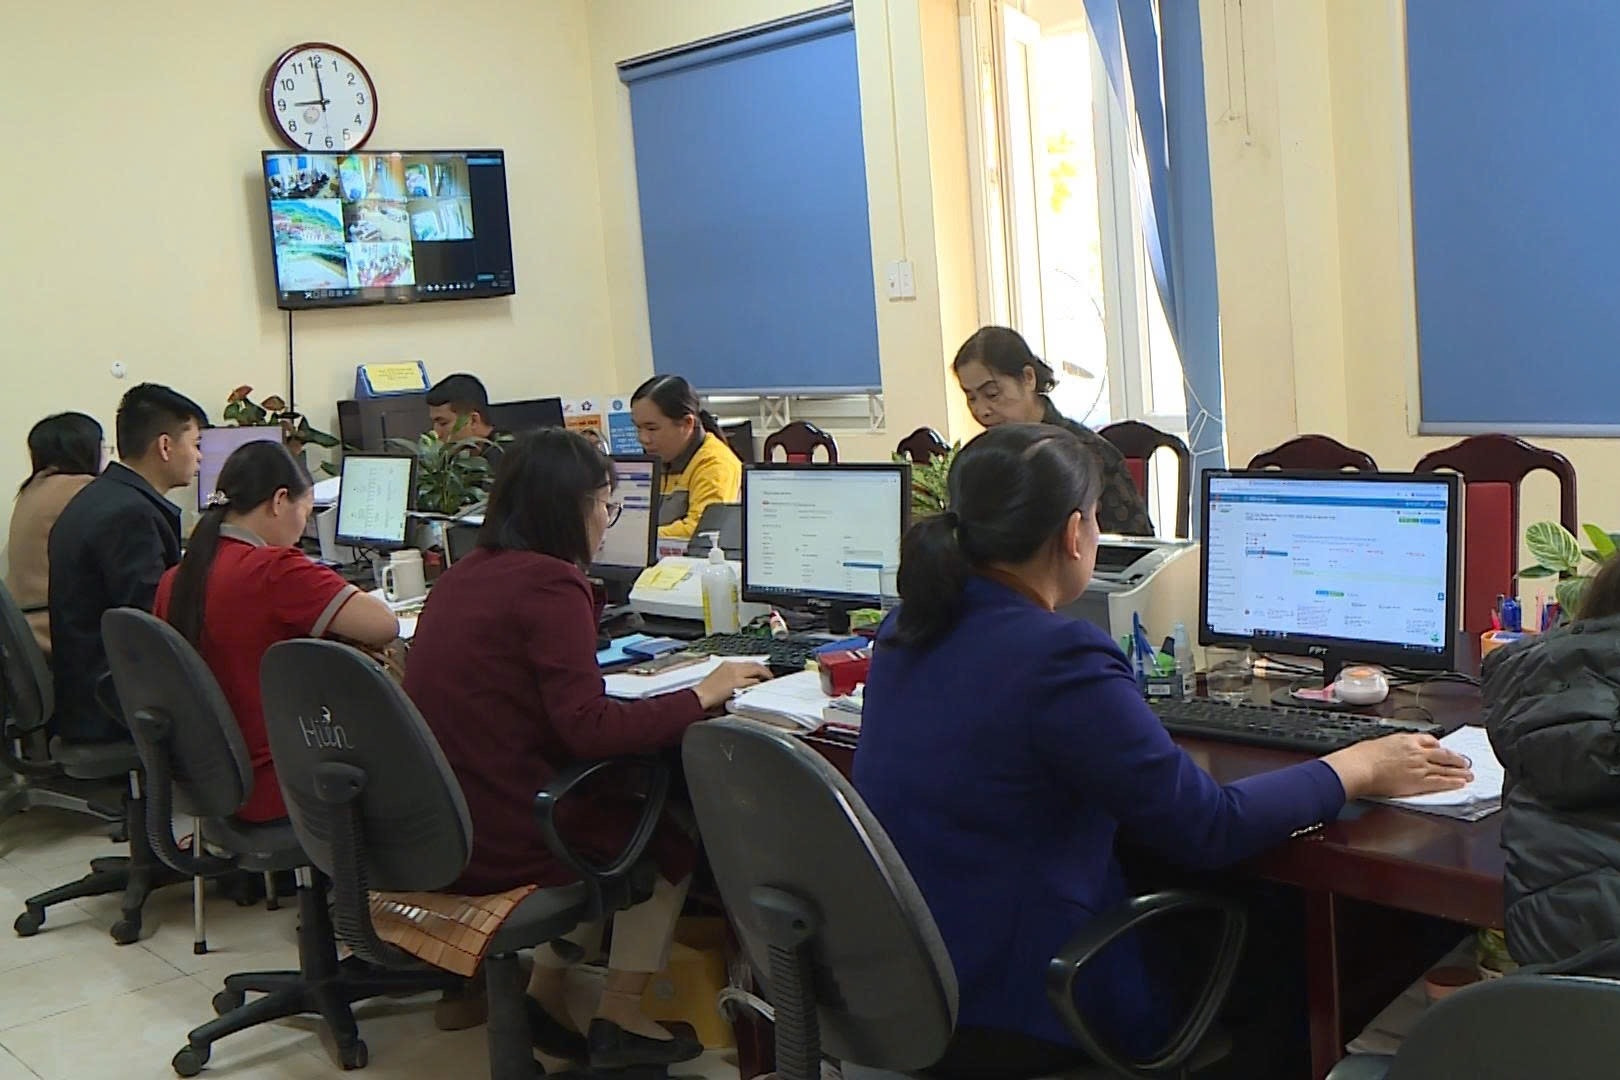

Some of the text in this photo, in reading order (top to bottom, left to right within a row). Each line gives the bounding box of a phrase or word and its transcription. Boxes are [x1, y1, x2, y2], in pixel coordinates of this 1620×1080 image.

[308, 55, 322, 69] 12
[332, 60, 338, 72] 1
[292, 62, 304, 75] 11
[281, 79, 295, 91] 10
[346, 73, 356, 86] 2
[356, 92, 365, 105] 3
[277, 99, 287, 111] 9
[288, 119, 297, 132] 8
[353, 114, 362, 126] 4
[304, 132, 313, 144] 7
[342, 128, 351, 141] 5
[324, 136, 334, 148] 6
